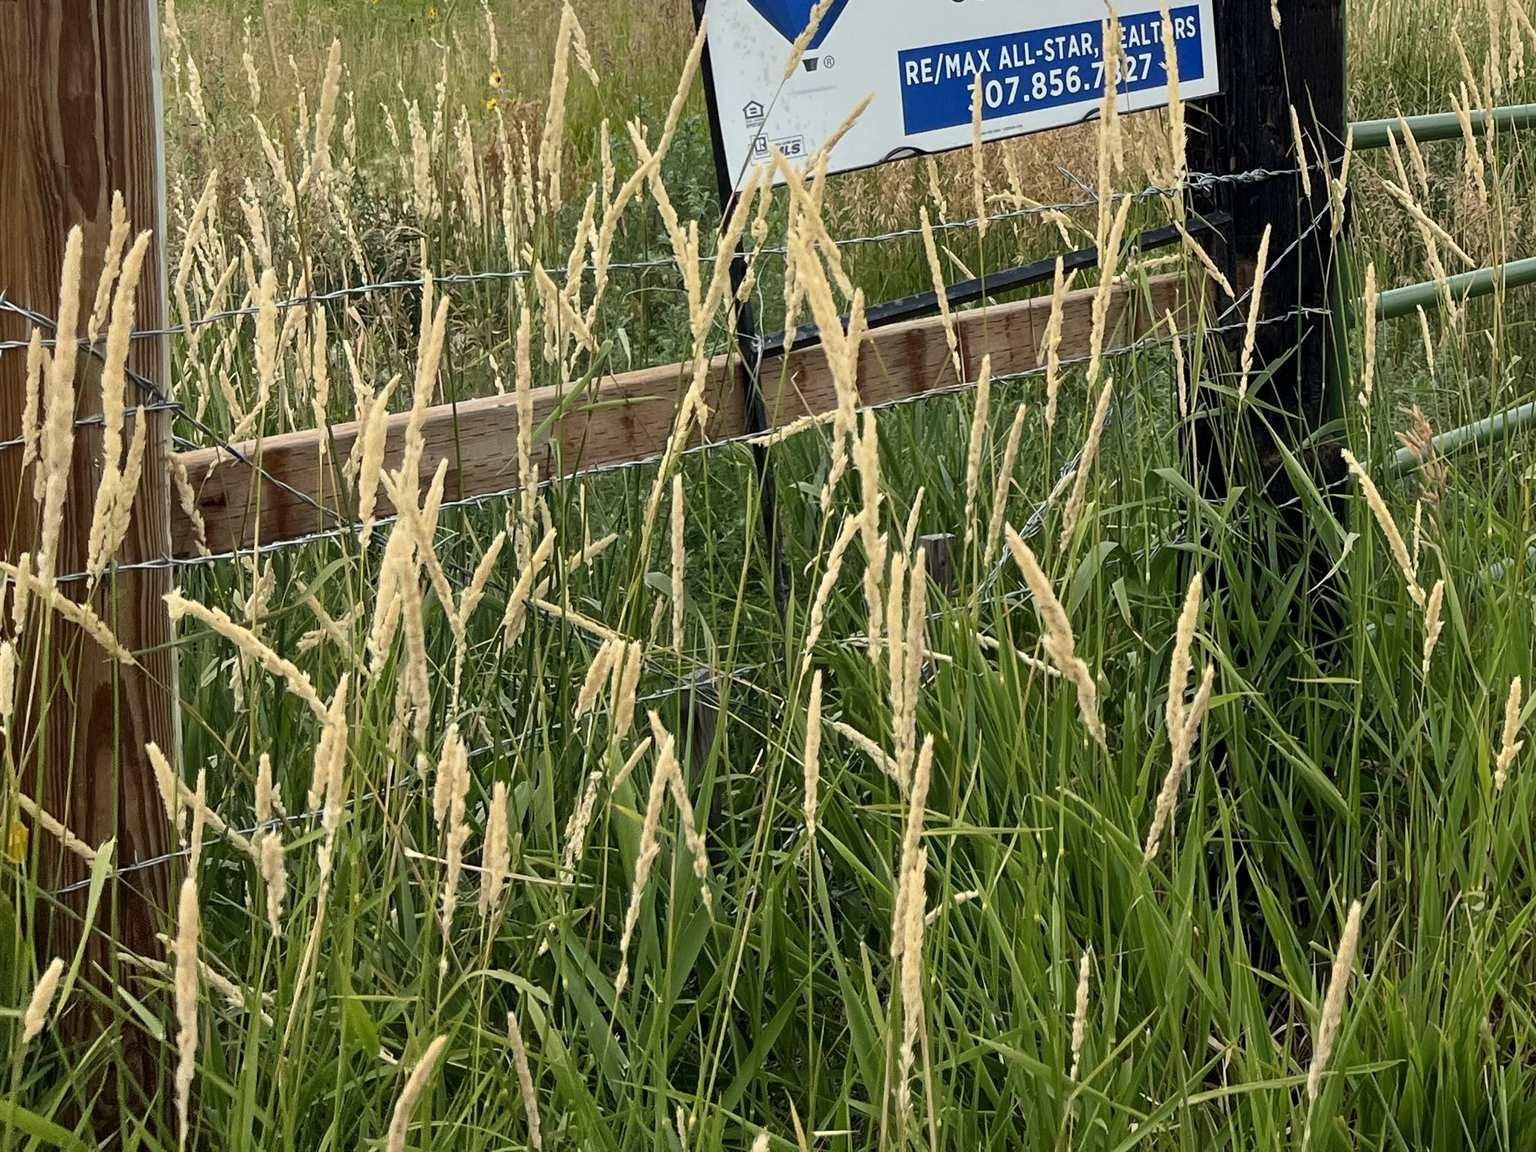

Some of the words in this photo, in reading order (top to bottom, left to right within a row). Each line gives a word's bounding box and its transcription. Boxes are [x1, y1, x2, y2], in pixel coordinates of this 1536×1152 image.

[905, 48, 992, 86] RE/MAX
[998, 31, 1099, 71] ALL-STAR,
[1104, 15, 1197, 52] EALTRS
